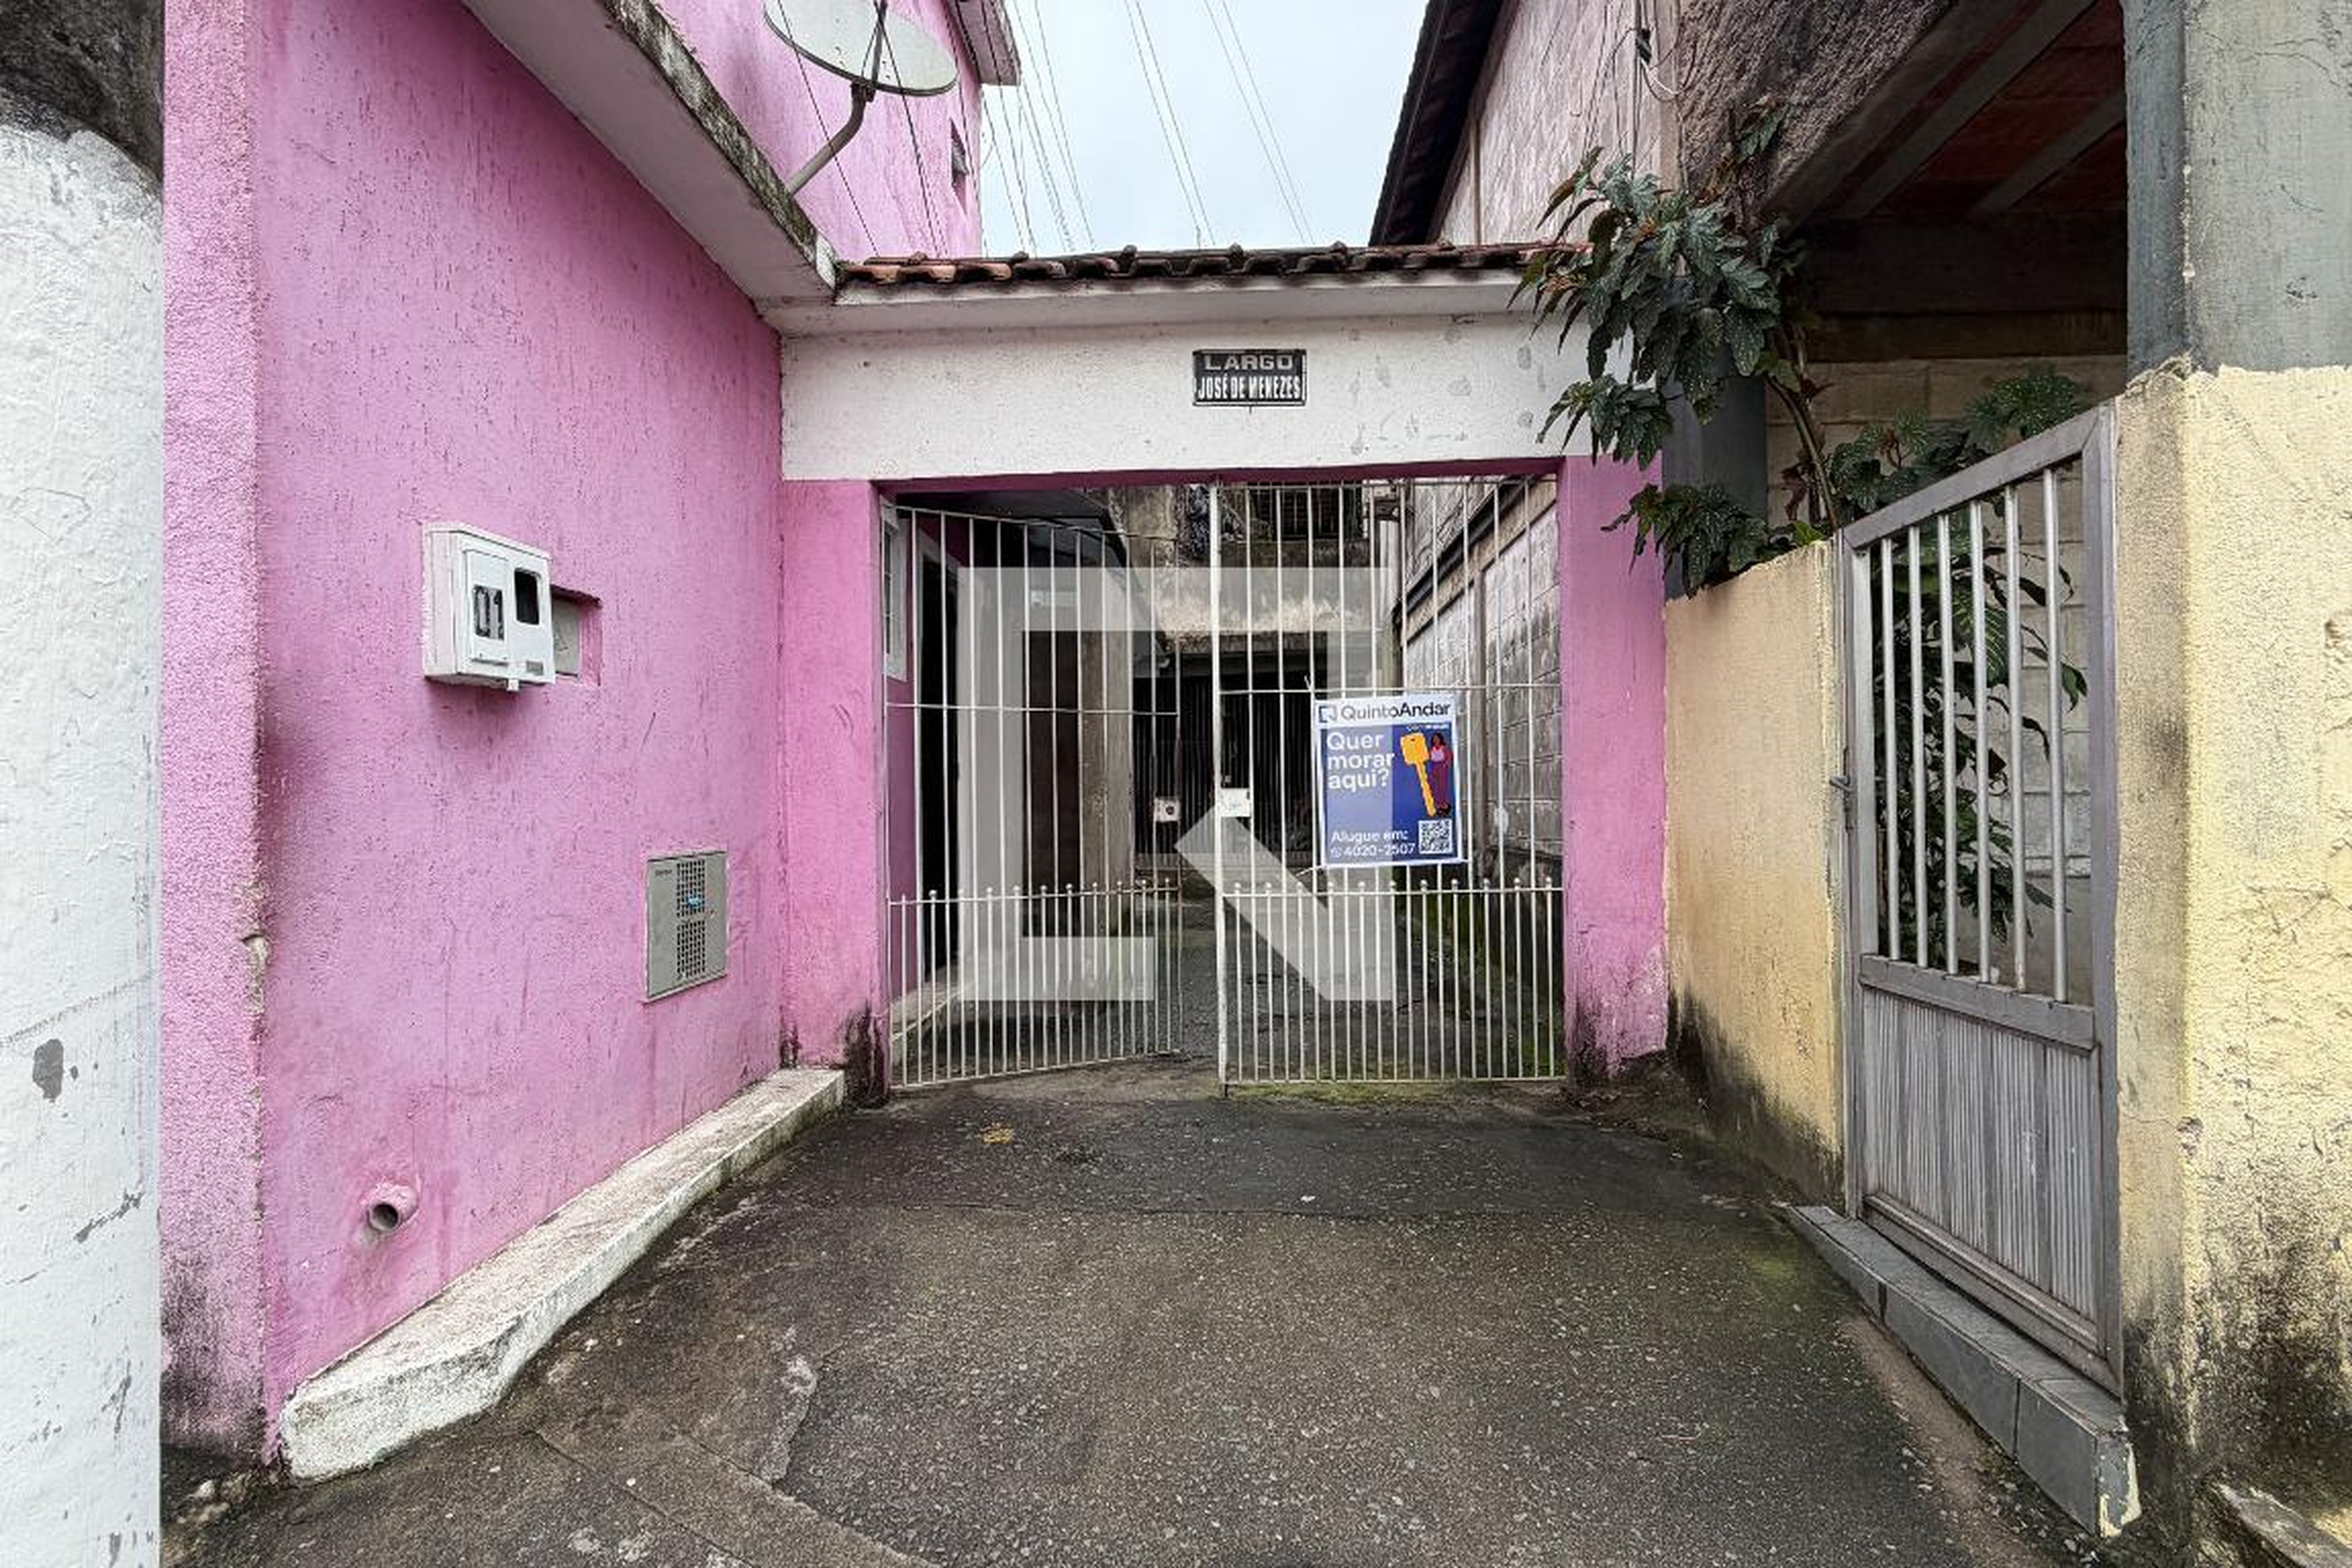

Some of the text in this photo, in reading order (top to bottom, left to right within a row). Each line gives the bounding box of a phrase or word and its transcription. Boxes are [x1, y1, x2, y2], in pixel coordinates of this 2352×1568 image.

[1204, 355, 1294, 370] LARGO
[1231, 376, 1246, 398] DE
[1249, 375, 1300, 399] MENEZES
[1341, 703, 1450, 721] QuintoAndar
[1327, 733, 1384, 750] Quer
[1328, 753, 1395, 769] morar
[1329, 768, 1389, 792] aqui?
[1332, 829, 1408, 845] Alugue em:
[1345, 843, 1416, 857] 4020-2507
